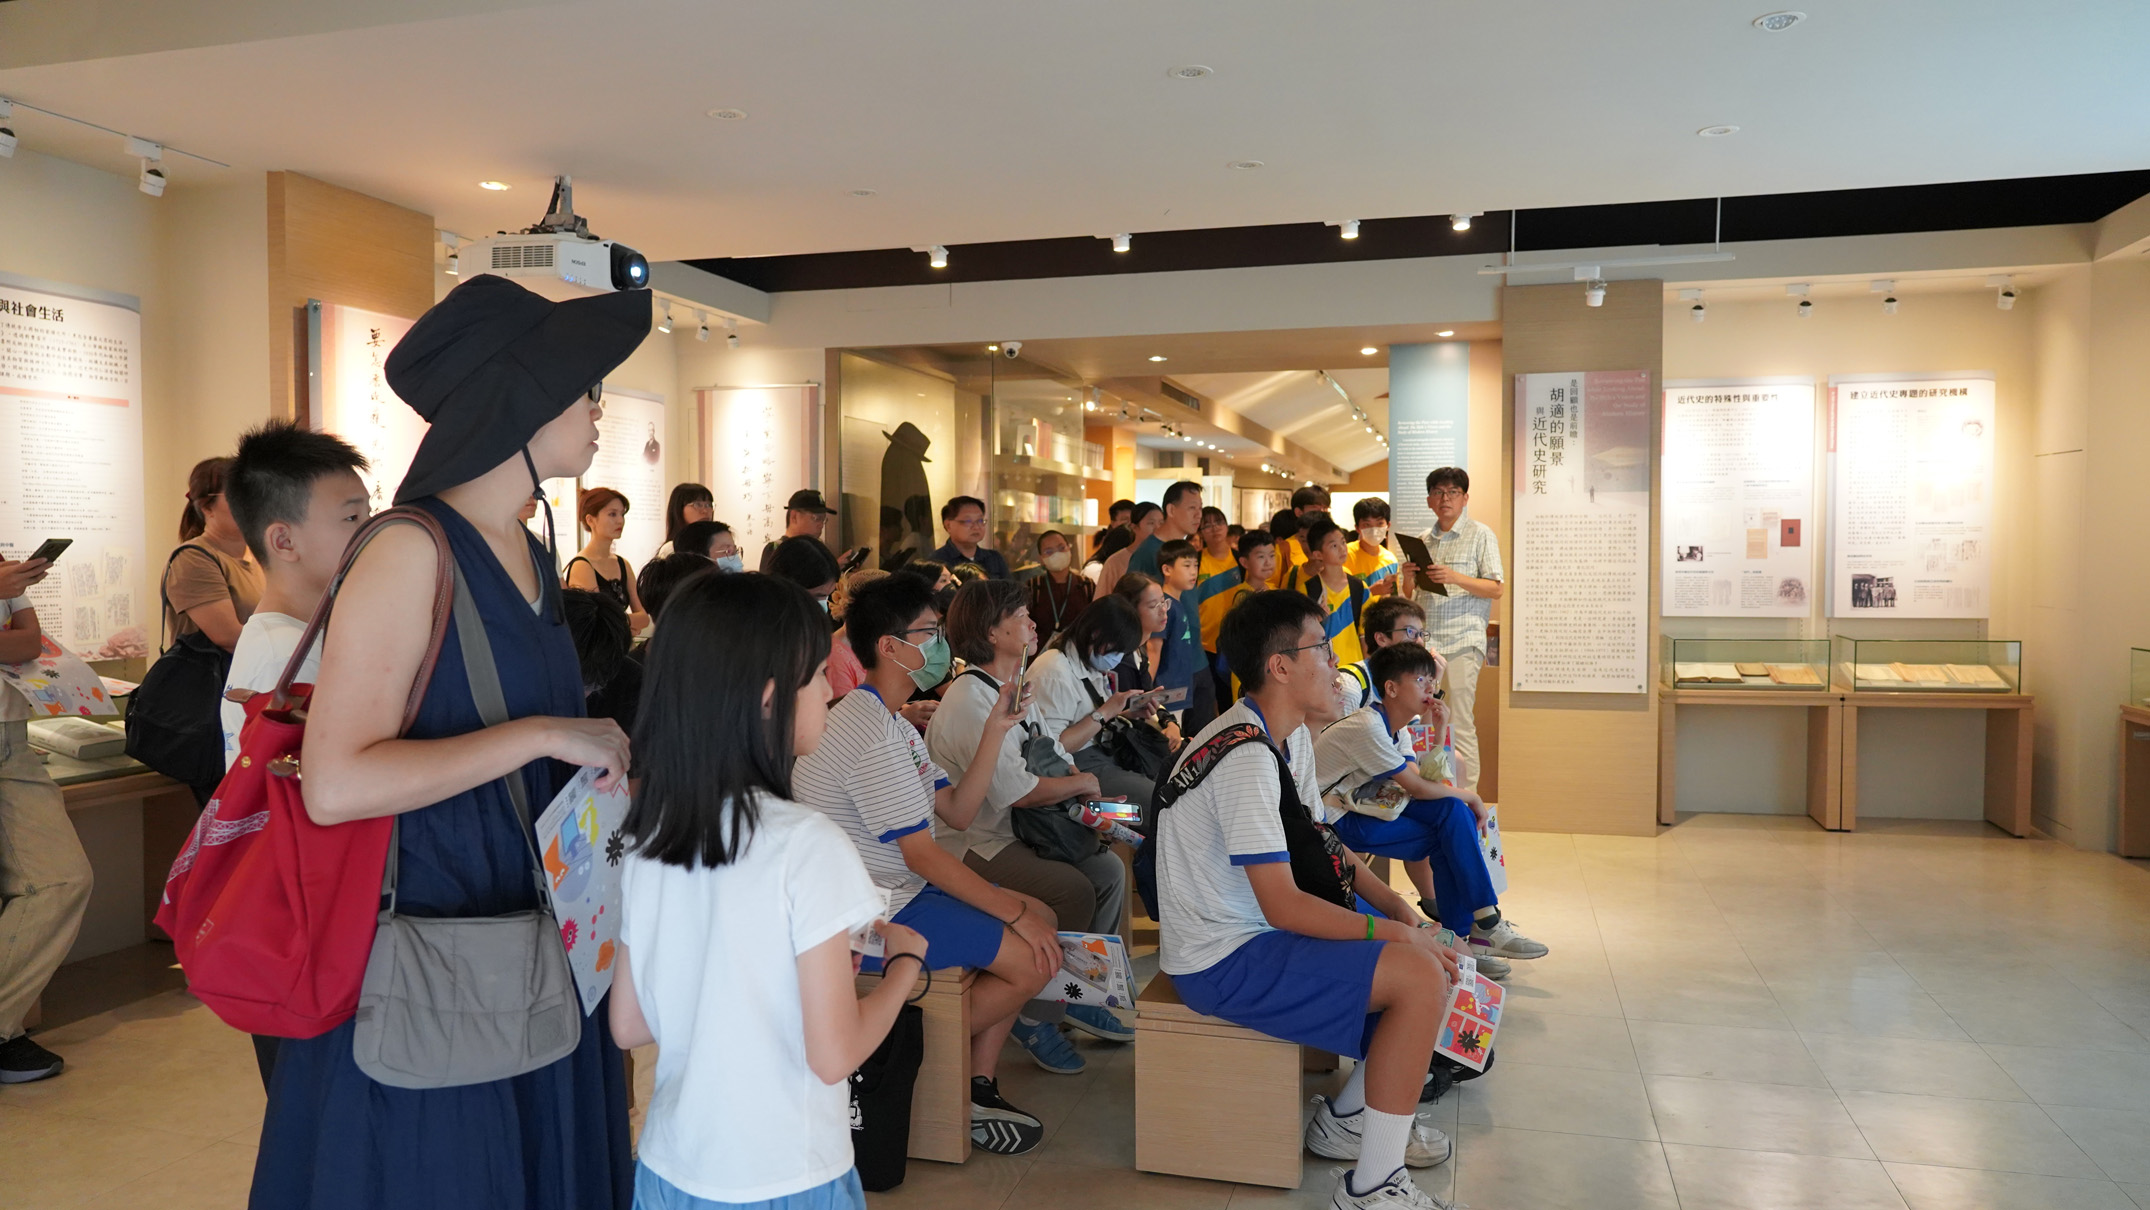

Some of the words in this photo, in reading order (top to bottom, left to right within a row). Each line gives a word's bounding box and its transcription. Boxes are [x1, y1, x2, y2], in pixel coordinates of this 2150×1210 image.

[0, 299, 64, 322] 與社會生活
[1549, 387, 1565, 466] 胡適的願景
